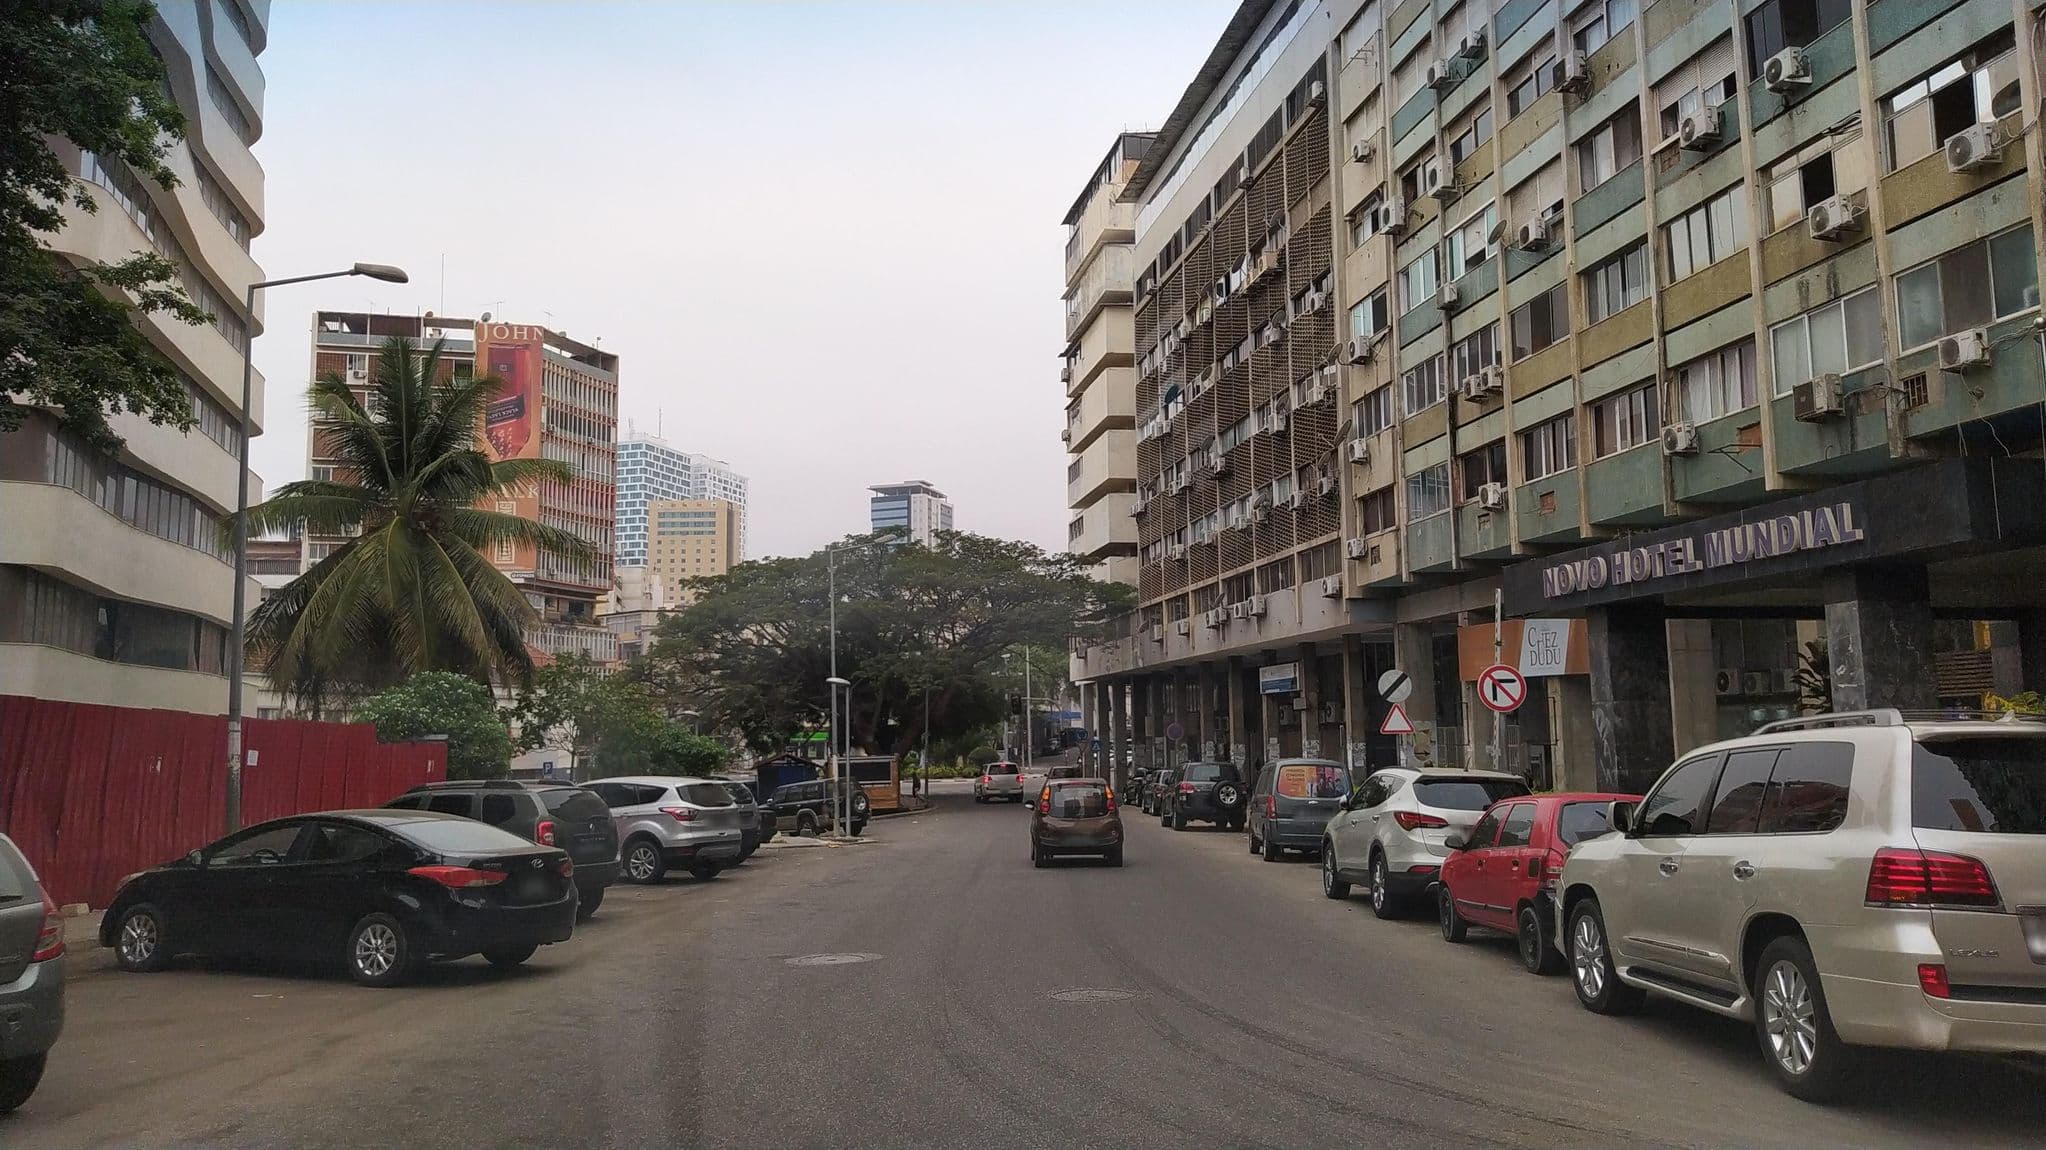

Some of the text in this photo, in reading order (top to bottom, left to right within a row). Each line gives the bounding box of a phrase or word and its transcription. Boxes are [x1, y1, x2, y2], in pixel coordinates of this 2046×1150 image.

[479, 323, 544, 343] JOHN
[1543, 502, 1863, 597] NOVO HOTEL MUNDIAL
[1528, 627, 1558, 650] CHEZ
[1530, 644, 1562, 666] DUDU
[545, 763, 551, 773] P
